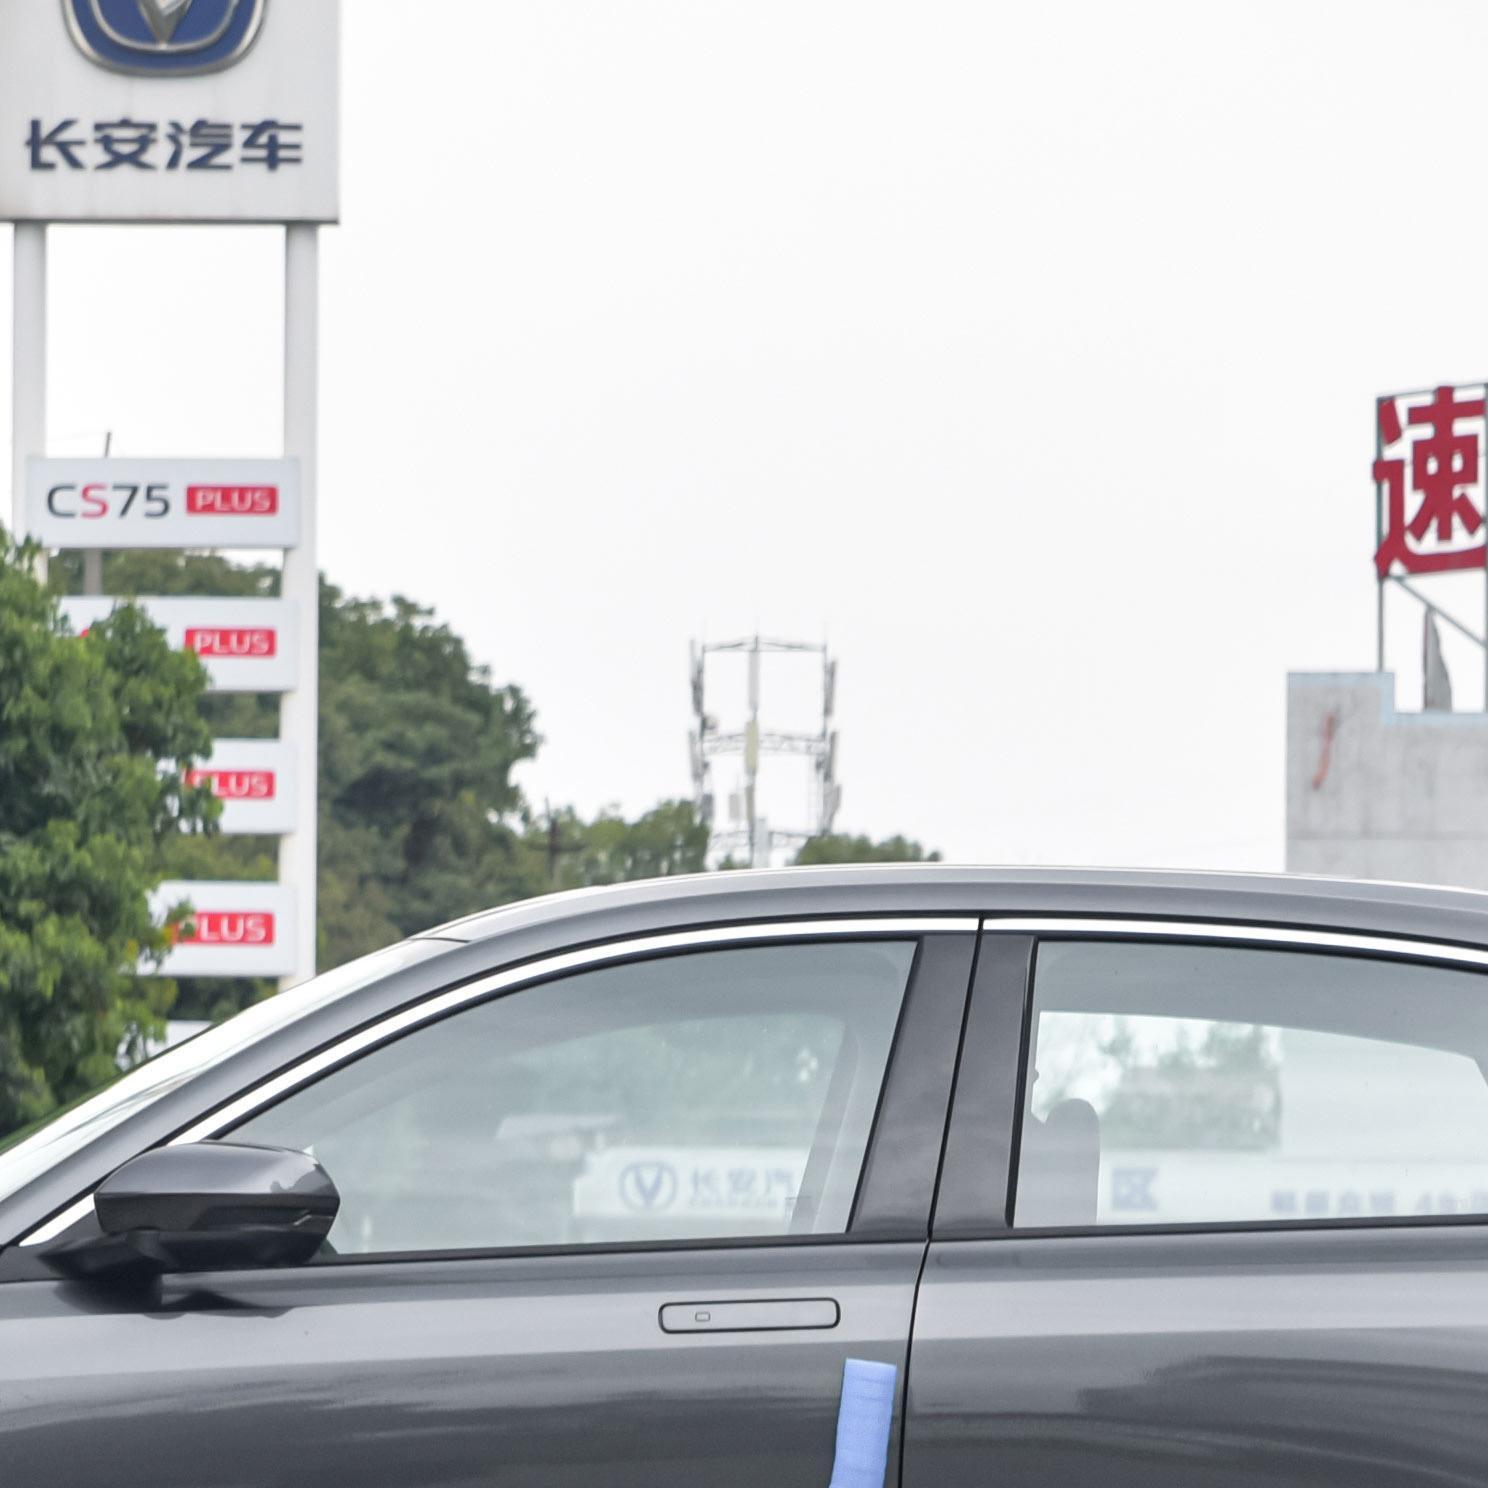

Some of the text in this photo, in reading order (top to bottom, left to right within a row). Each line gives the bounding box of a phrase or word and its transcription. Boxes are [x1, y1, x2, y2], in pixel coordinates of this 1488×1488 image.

[25, 117, 303, 171] 长安汽车
[46, 484, 273, 519] CS75 PLUS
[192, 632, 270, 655] PLUS
